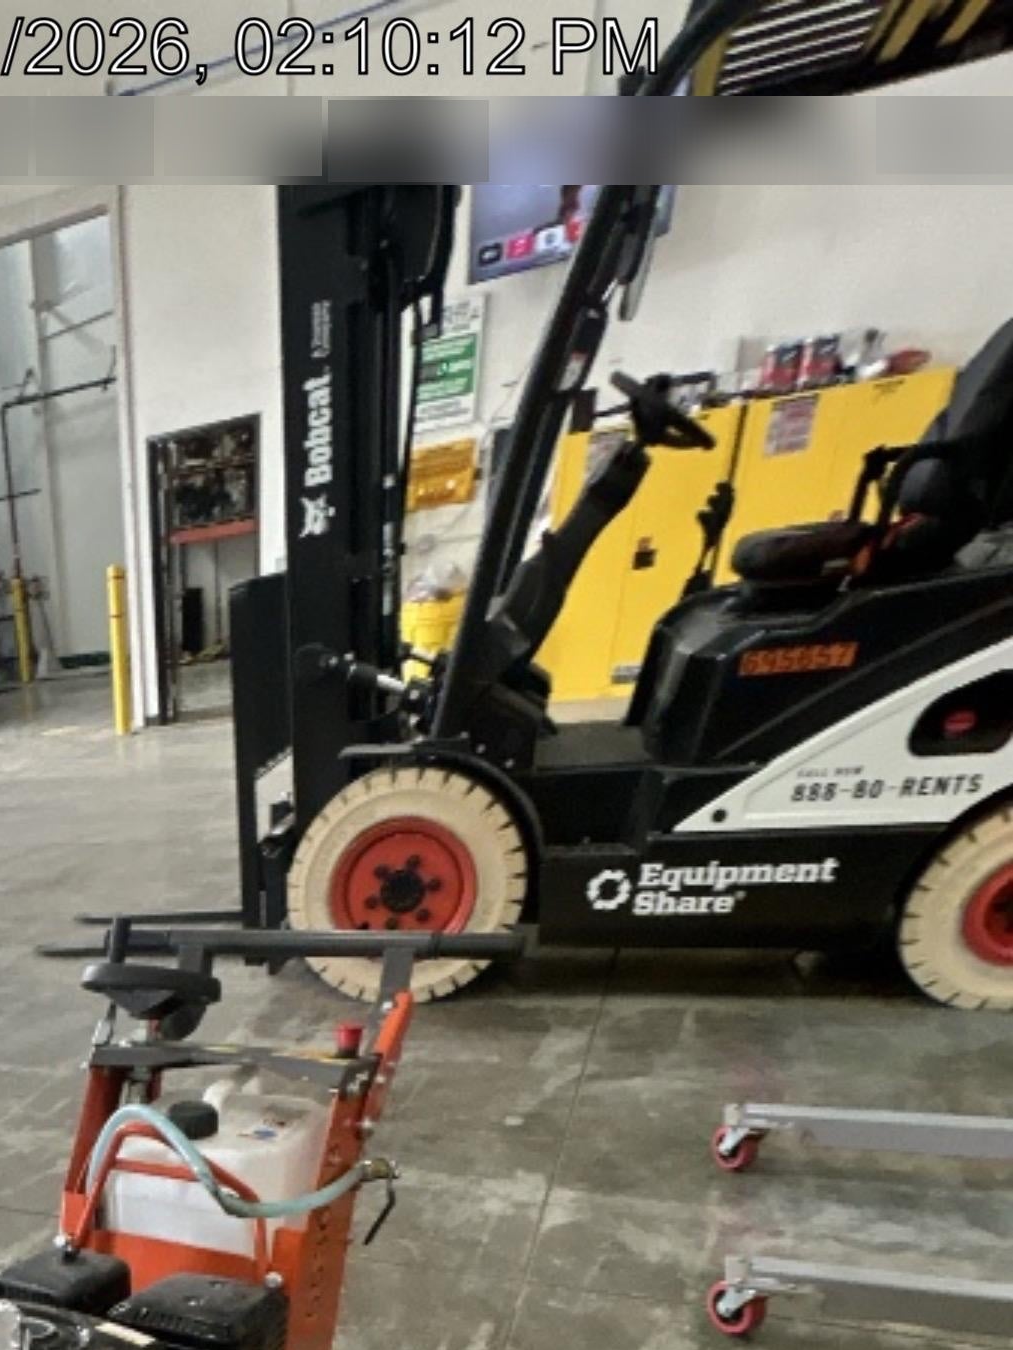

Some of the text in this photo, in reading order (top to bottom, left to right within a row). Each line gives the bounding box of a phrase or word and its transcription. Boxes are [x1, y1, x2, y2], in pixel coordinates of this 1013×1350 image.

[303, 373, 333, 487] Bobcat
[791, 773, 984, 802] 888-80-RENTS
[638, 857, 840, 892] Equipment
[632, 890, 736, 916] Share
